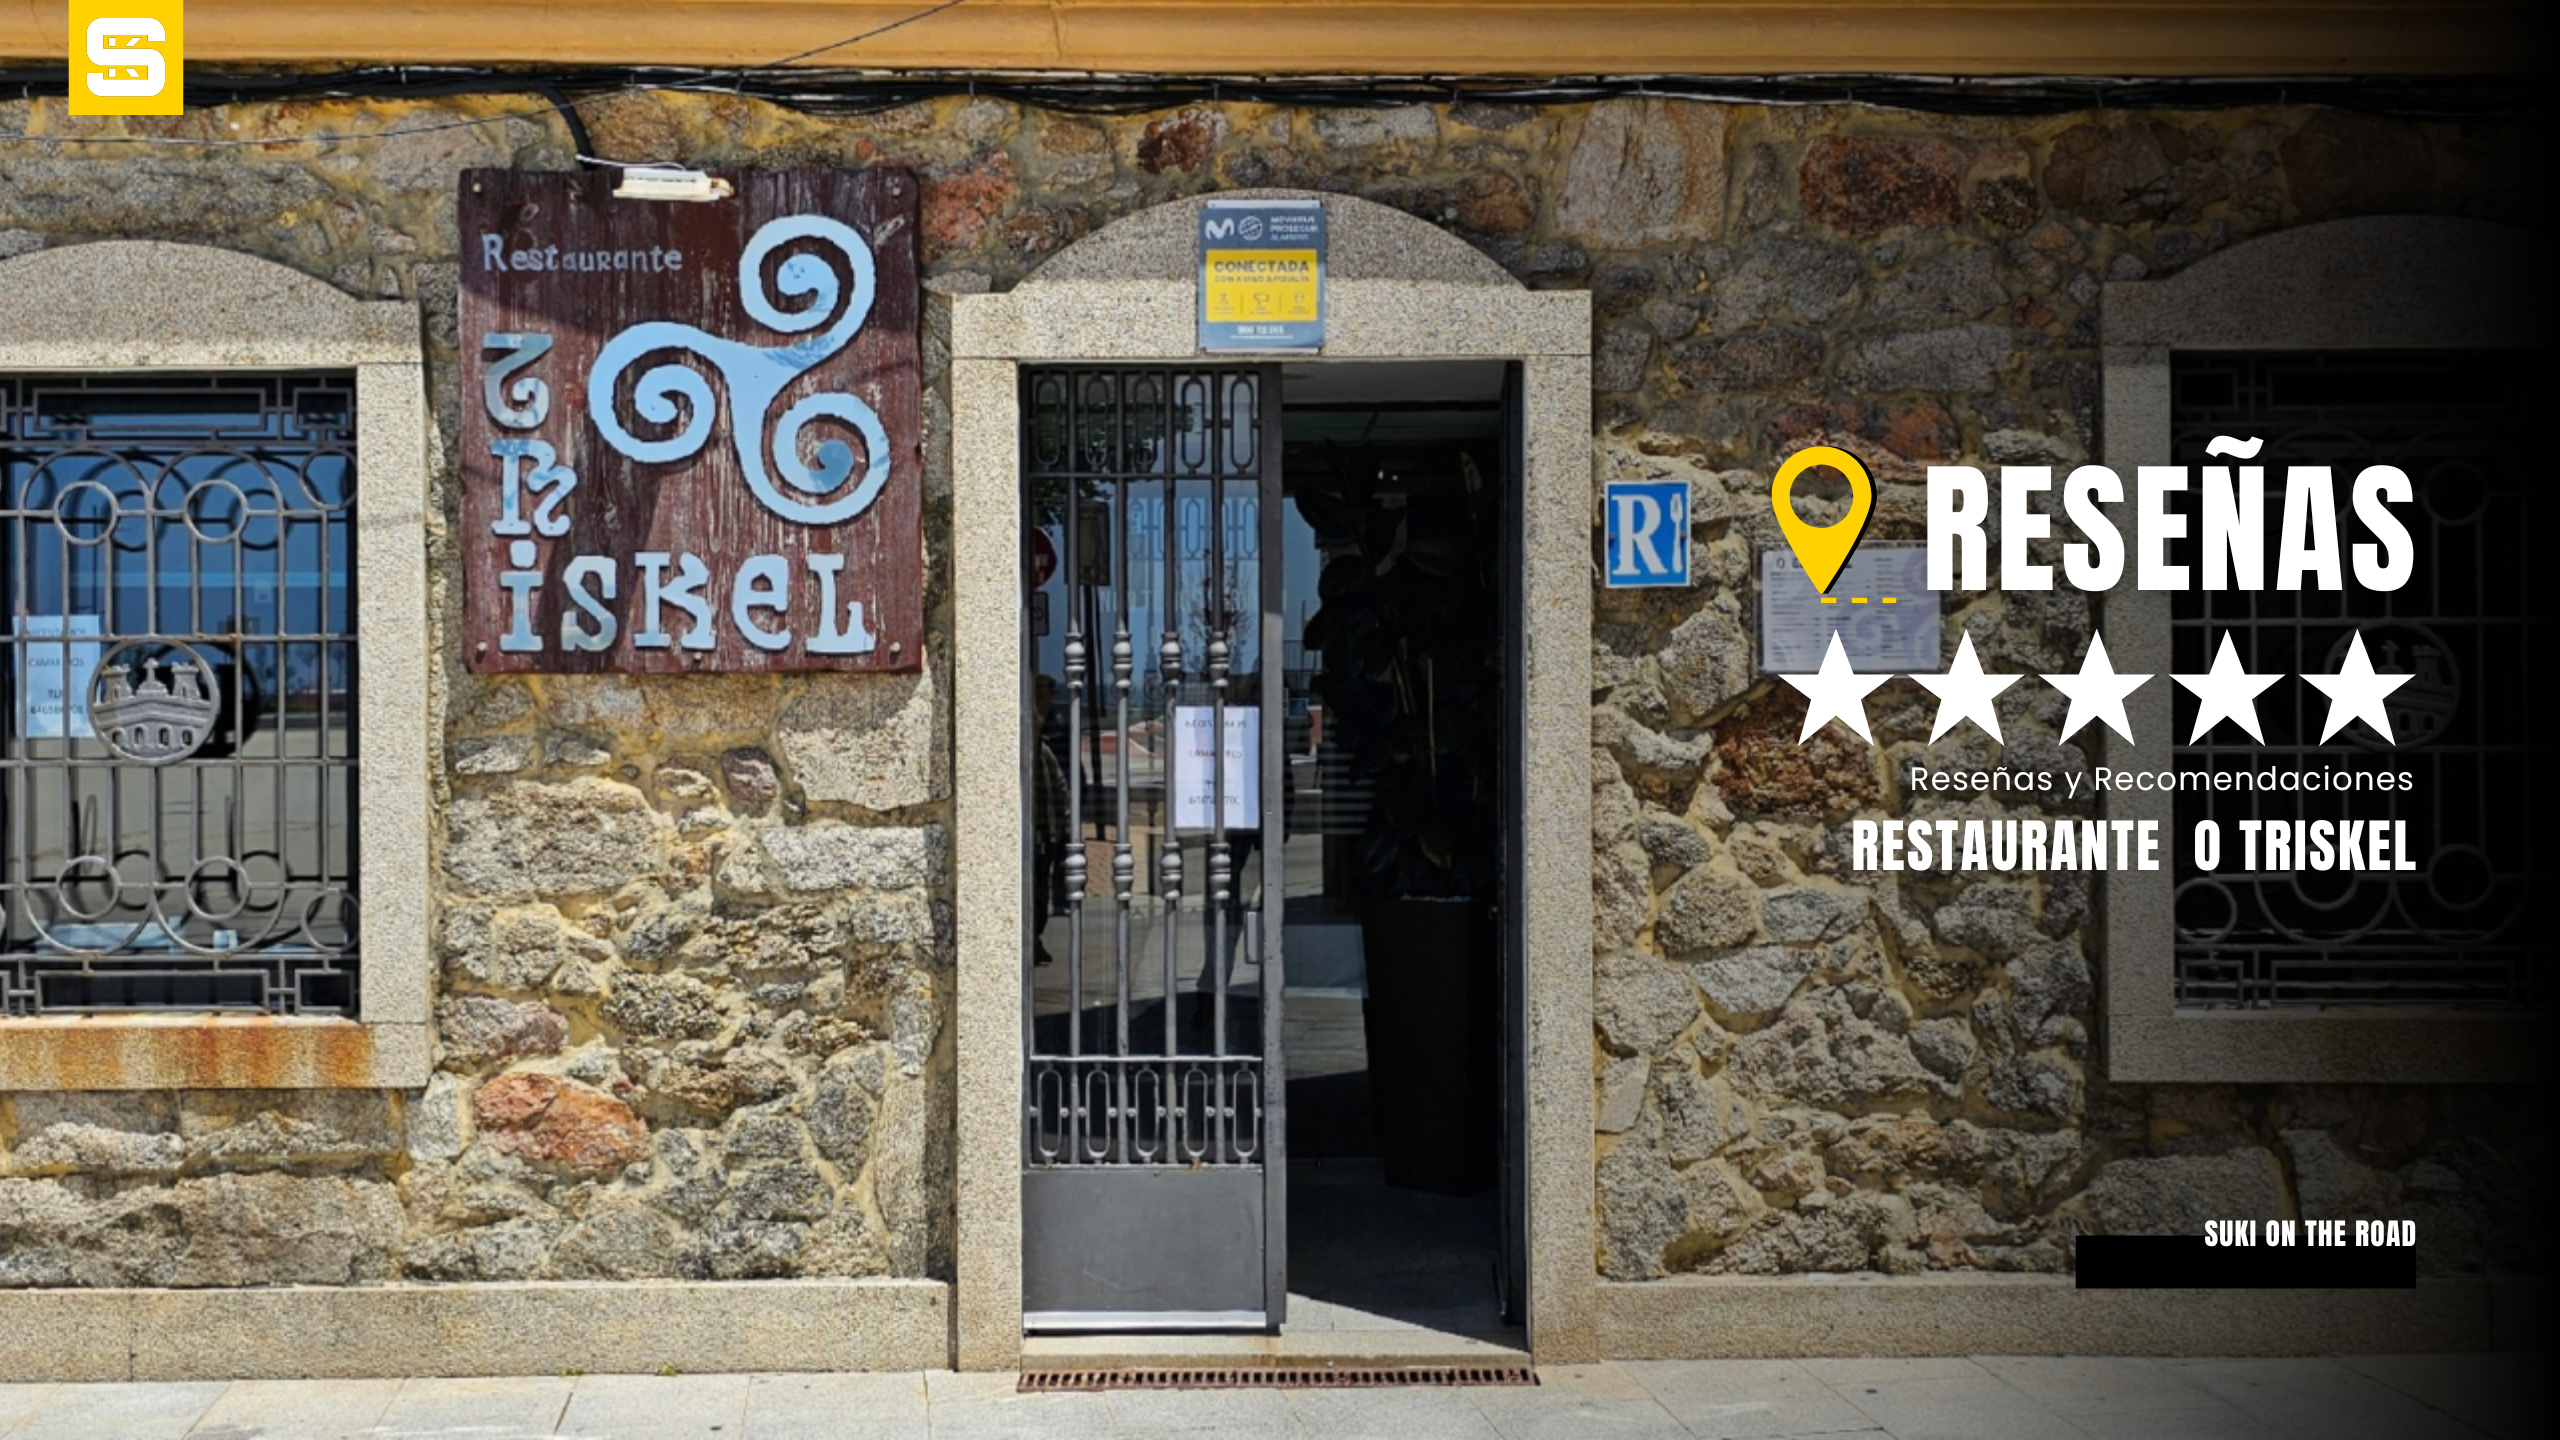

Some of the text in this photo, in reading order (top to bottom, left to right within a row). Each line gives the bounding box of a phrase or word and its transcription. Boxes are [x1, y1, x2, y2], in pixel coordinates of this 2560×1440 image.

[481, 233, 683, 272] Restaurante
[1214, 261, 1309, 273] CONECTADA
[1611, 494, 1669, 575] R
